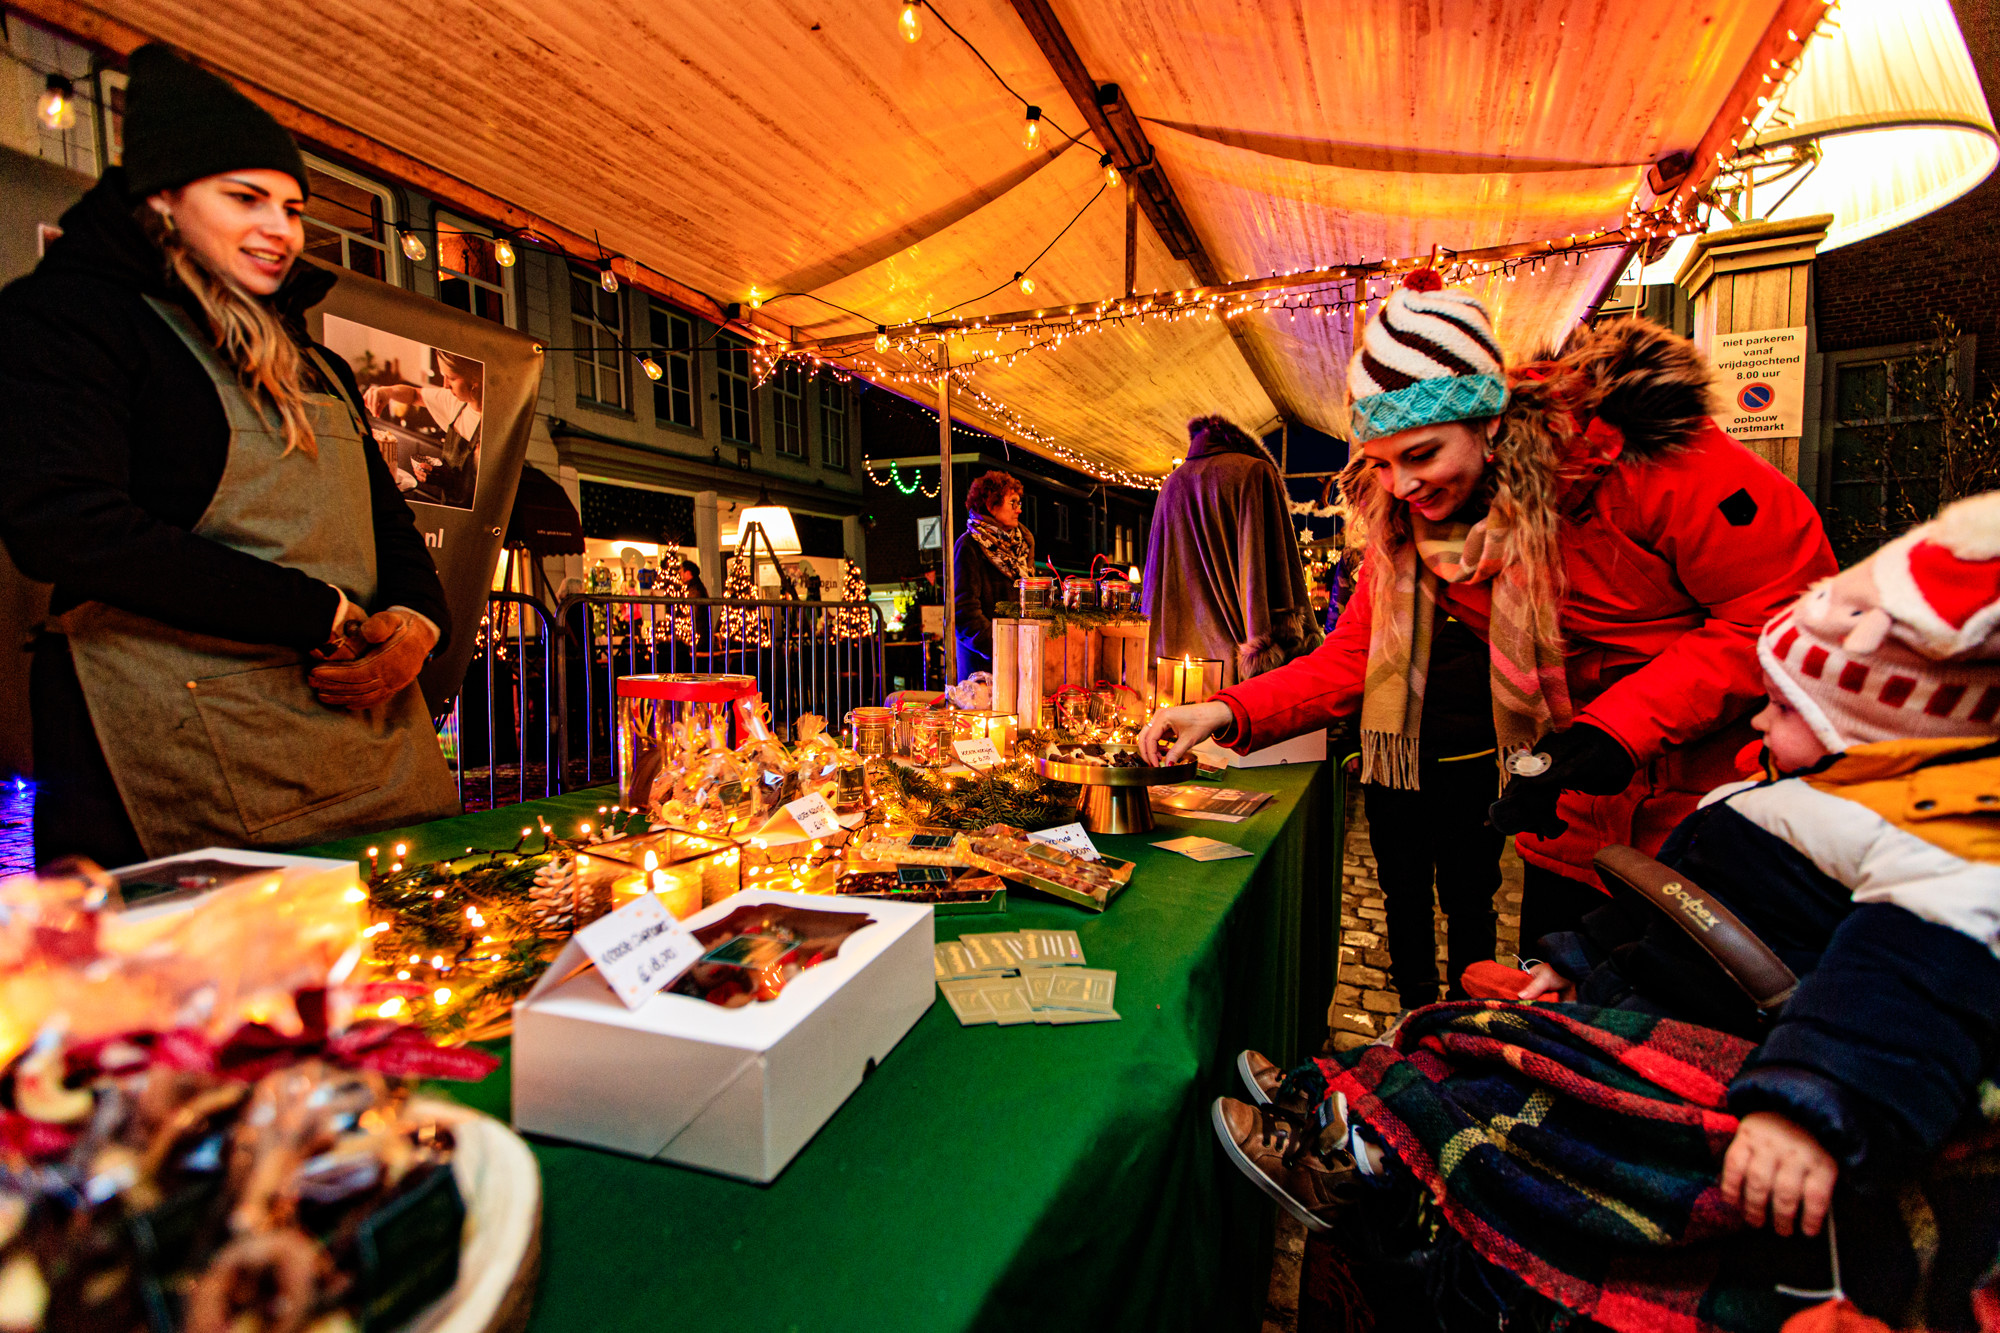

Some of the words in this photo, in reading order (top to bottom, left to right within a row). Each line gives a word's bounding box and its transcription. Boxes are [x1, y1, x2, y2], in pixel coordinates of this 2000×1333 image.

[1722, 338, 1743, 347] niet
[1746, 334, 1795, 347] parkeren
[1743, 347, 1774, 357] vanaf
[1718, 355, 1800, 370] vrijdagochtend
[1736, 371, 1759, 380] 8.00
[1762, 370, 1781, 378] uur
[1733, 415, 1778, 424] opbouw
[1726, 423, 1785, 434] kerstmarkt
[1675, 891, 1720, 928] cybex
